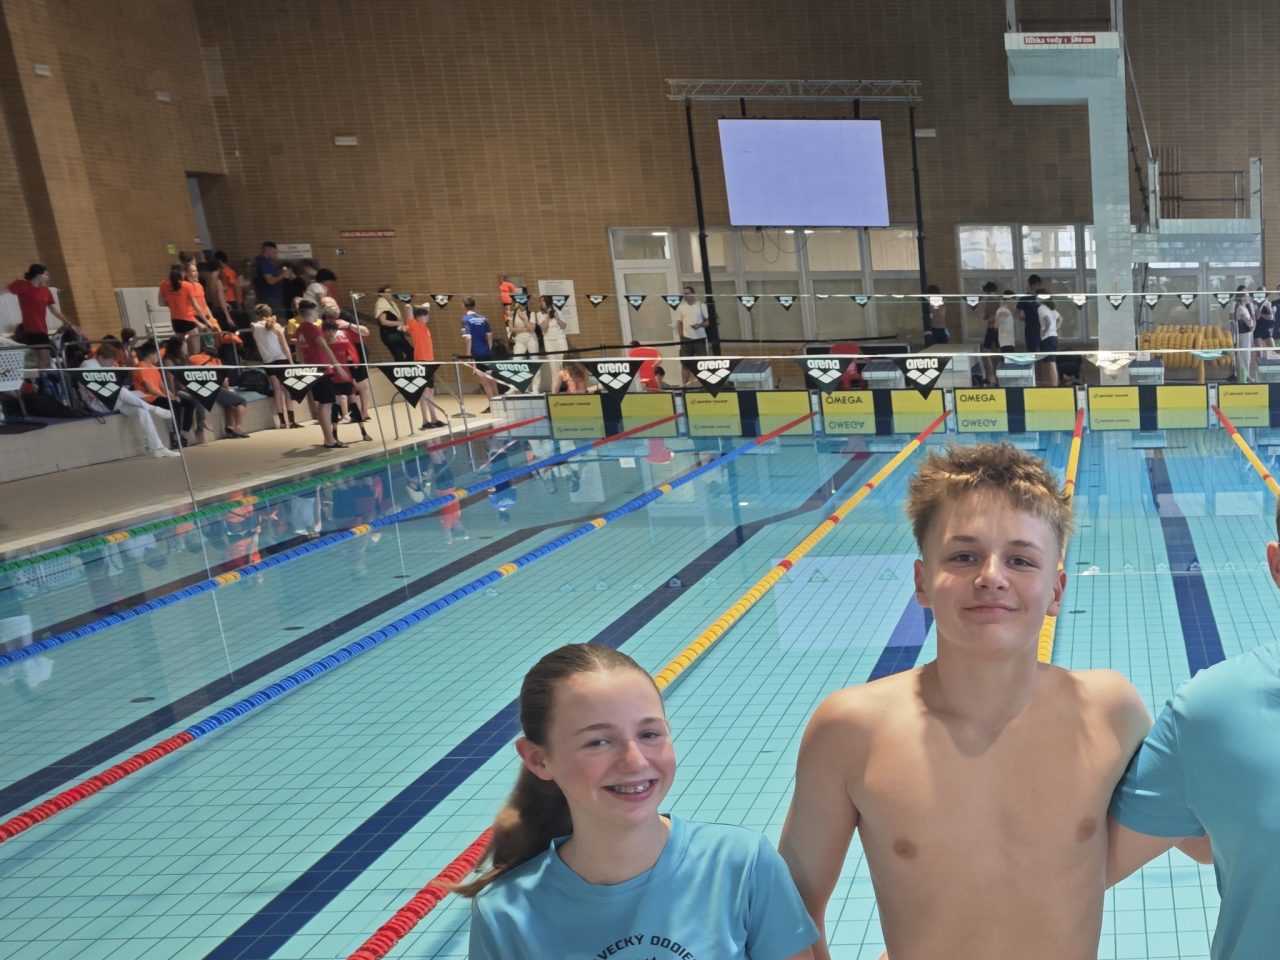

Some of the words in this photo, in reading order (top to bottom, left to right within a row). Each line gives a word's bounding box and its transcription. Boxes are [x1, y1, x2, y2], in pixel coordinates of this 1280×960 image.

[496, 363, 530, 372] arena
[597, 362, 630, 373] arena
[697, 360, 730, 370] arena
[807, 359, 840, 369] arena
[906, 358, 939, 369] arena
[184, 371, 217, 381] arena
[394, 365, 426, 377] arena
[82, 371, 117, 382] arena
[826, 395, 863, 405] OMEGA
[960, 393, 996, 403] OMEGA
